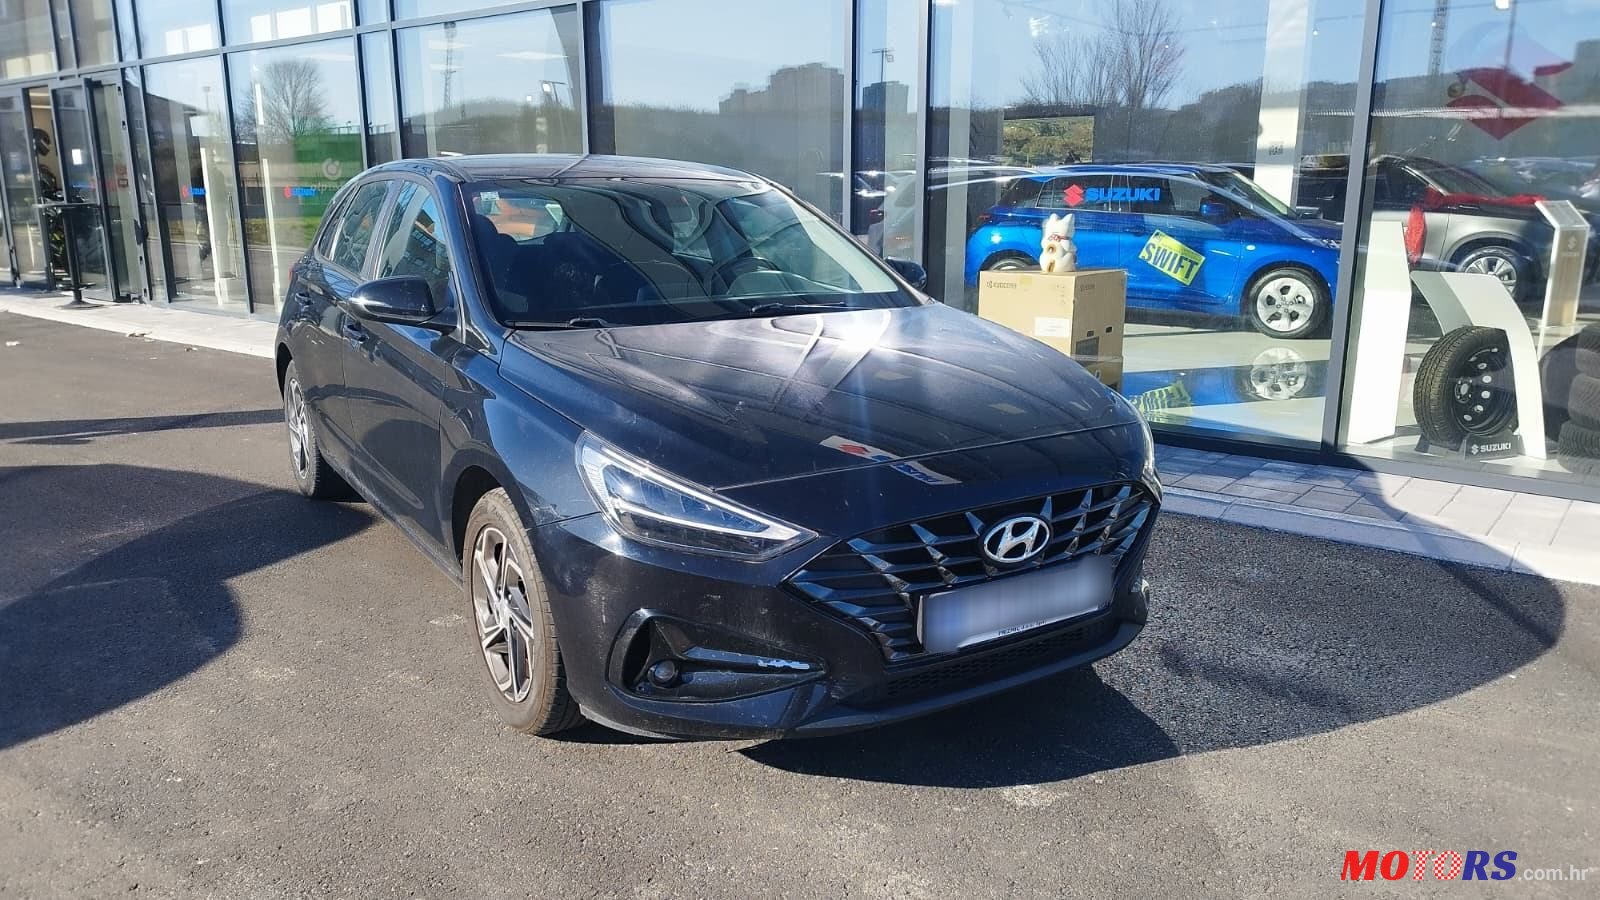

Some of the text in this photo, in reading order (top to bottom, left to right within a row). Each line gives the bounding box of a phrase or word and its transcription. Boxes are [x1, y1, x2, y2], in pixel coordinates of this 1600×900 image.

[1085, 187, 1161, 201] SUZUKI
[1143, 242, 1199, 279] SWIFT
[1480, 442, 1511, 452] SUZUKI
